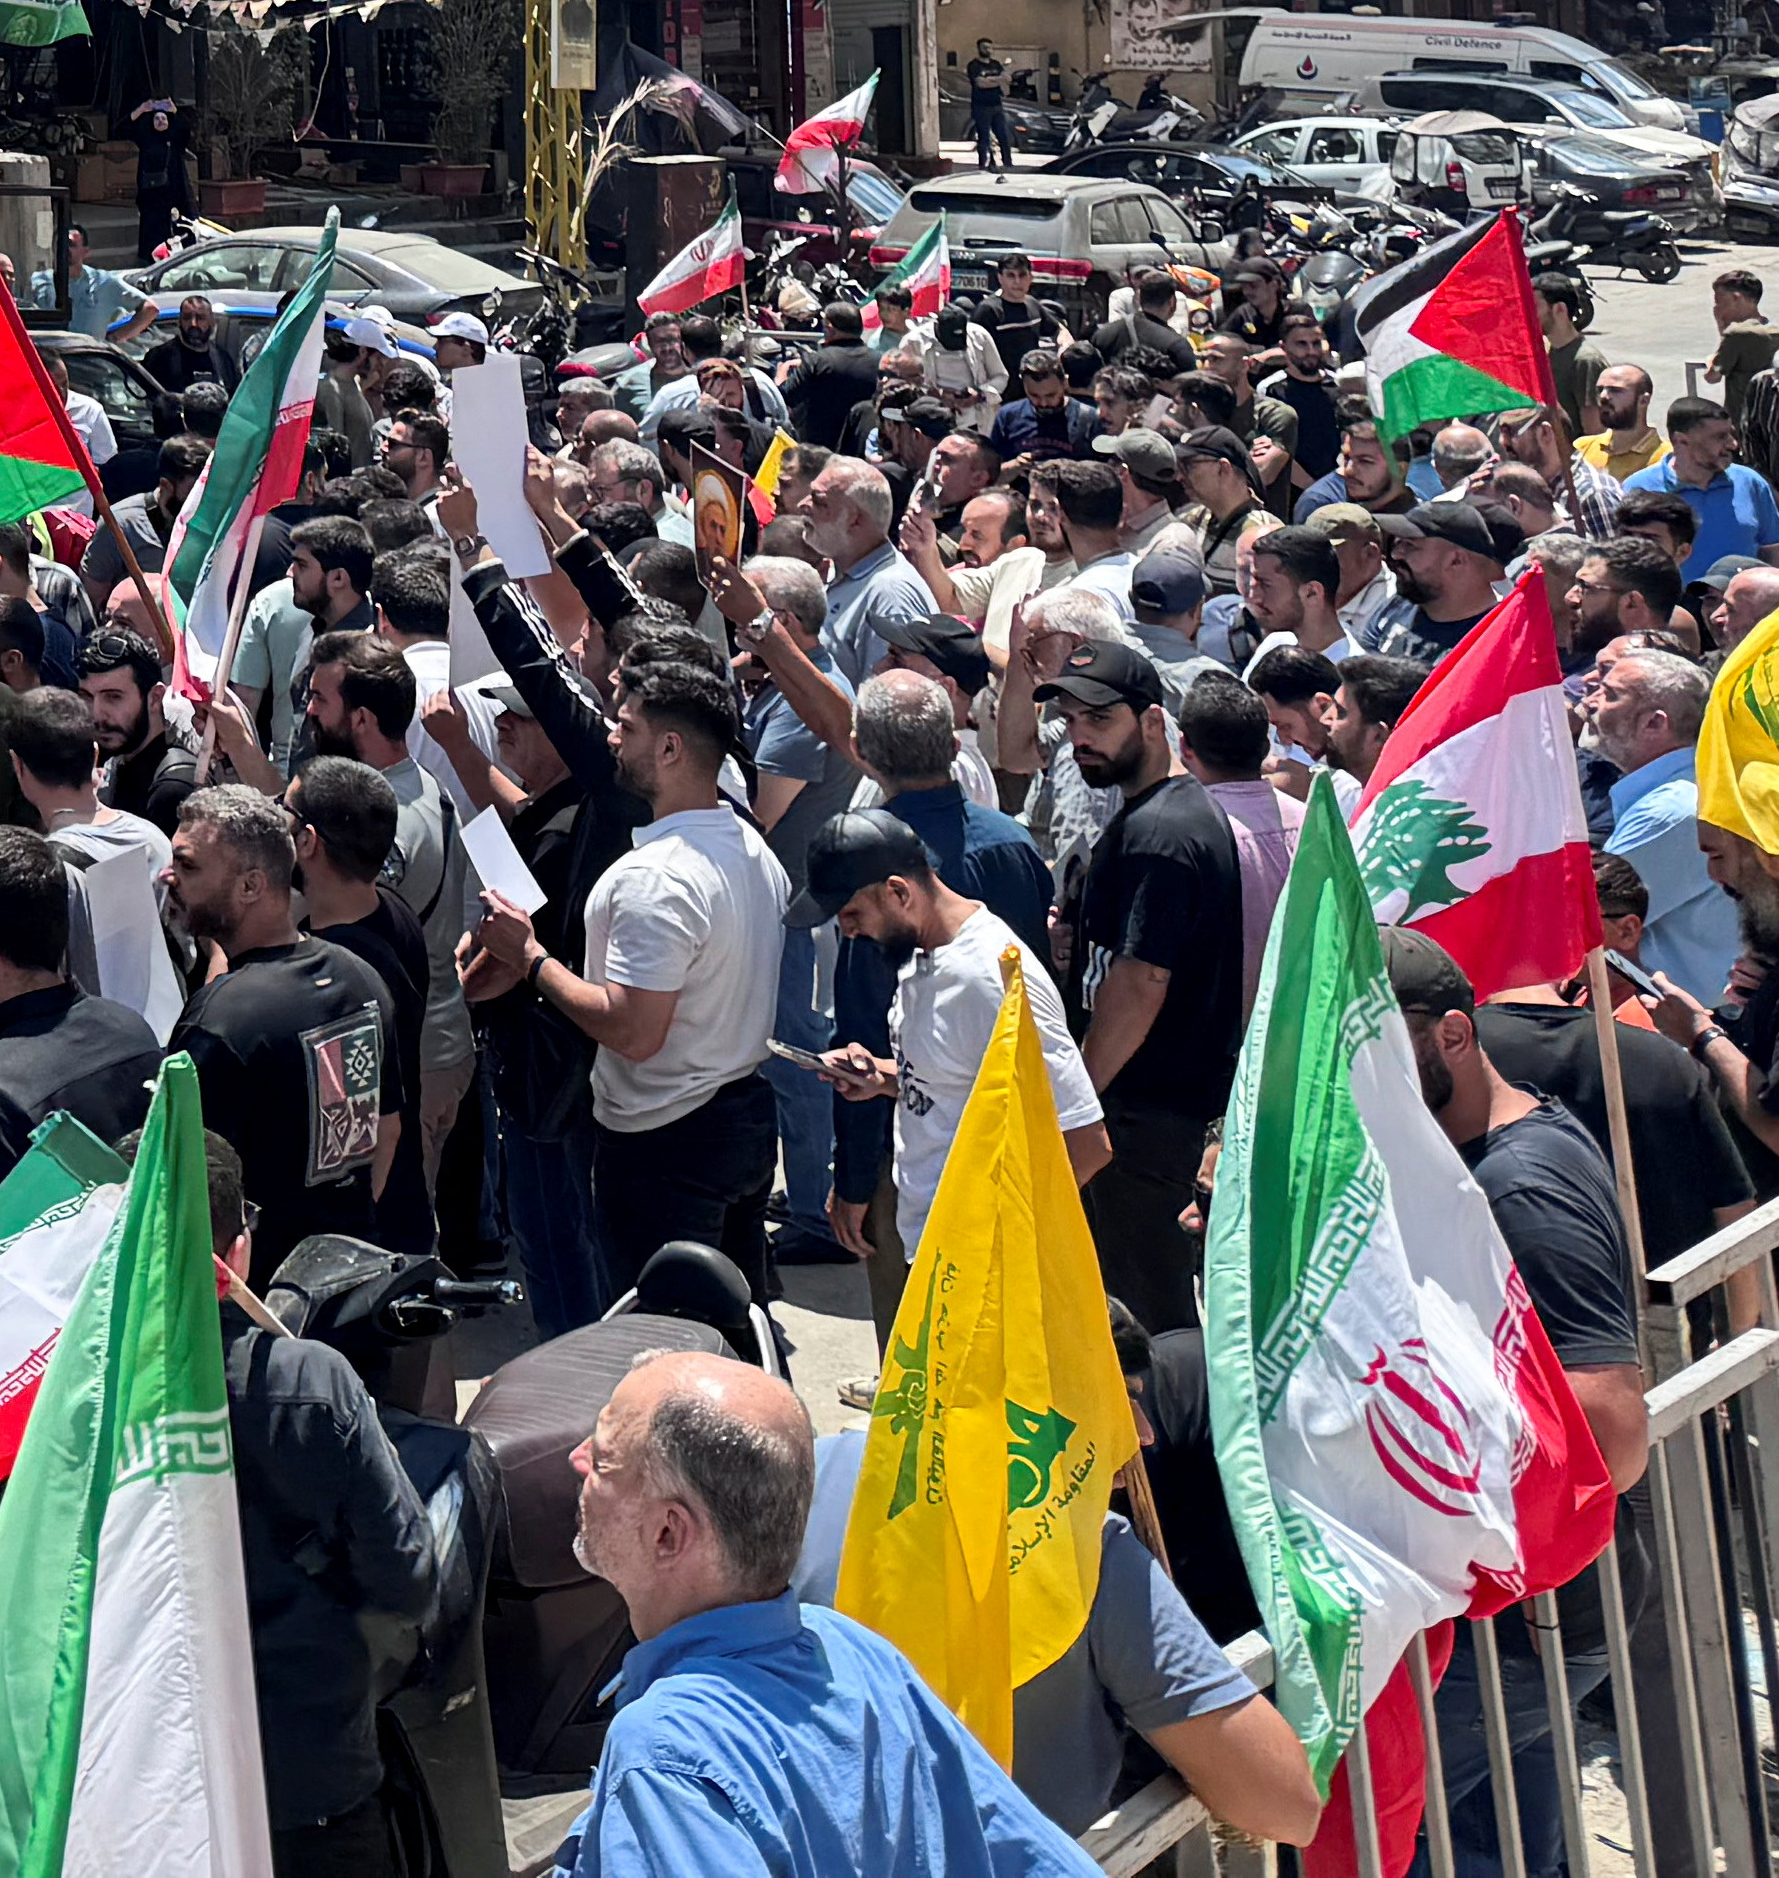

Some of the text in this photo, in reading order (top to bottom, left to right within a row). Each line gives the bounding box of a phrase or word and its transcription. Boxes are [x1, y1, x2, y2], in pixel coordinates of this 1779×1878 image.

[1425, 35, 1502, 50] Civil Defence
[1008, 1441, 1096, 1576] المقاومة الإسلامي
